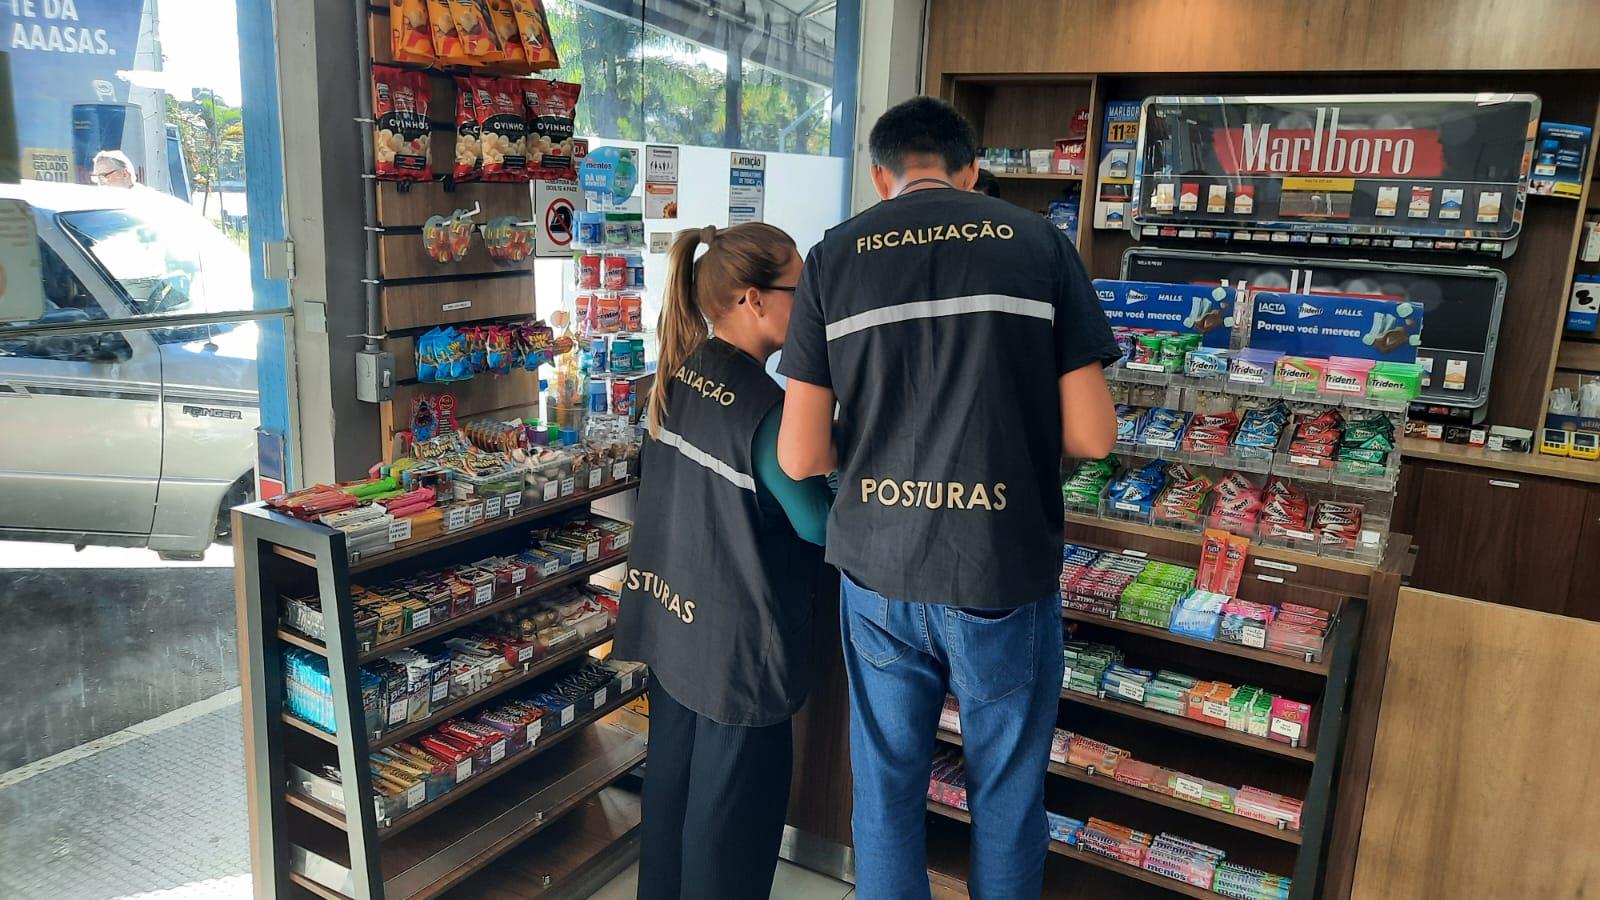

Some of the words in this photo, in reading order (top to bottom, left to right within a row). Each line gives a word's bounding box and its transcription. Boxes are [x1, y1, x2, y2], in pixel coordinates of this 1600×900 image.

[12, 23, 117, 55] AAASAS.
[389, 119, 429, 130] OVINHOS
[1238, 107, 1415, 175] Marlboro
[33, 161, 69, 171] GELADO
[738, 156, 761, 168] ATENÇÃO
[856, 220, 1015, 254] FISCALIZAÇÃO
[1258, 302, 1286, 314] LACTA
[1125, 310, 1145, 319] você
[1147, 313, 1182, 321] merece
[1257, 320, 1295, 333] Porque
[1297, 325, 1319, 335] você
[1321, 327, 1361, 338] merece
[1189, 360, 1218, 371] Trident
[1231, 364, 1263, 376] Trident
[1279, 368, 1311, 379] Trident
[1324, 374, 1357, 385] Trident
[1371, 380, 1404, 390] Trident
[861, 478, 1007, 511] POSTURAS
[1160, 581, 1183, 589] HALLS
[1093, 590, 1116, 600] HALLS
[1143, 601, 1167, 611] HALLS
[1156, 840, 1194, 858] mentos
[1147, 862, 1186, 882] mentos
